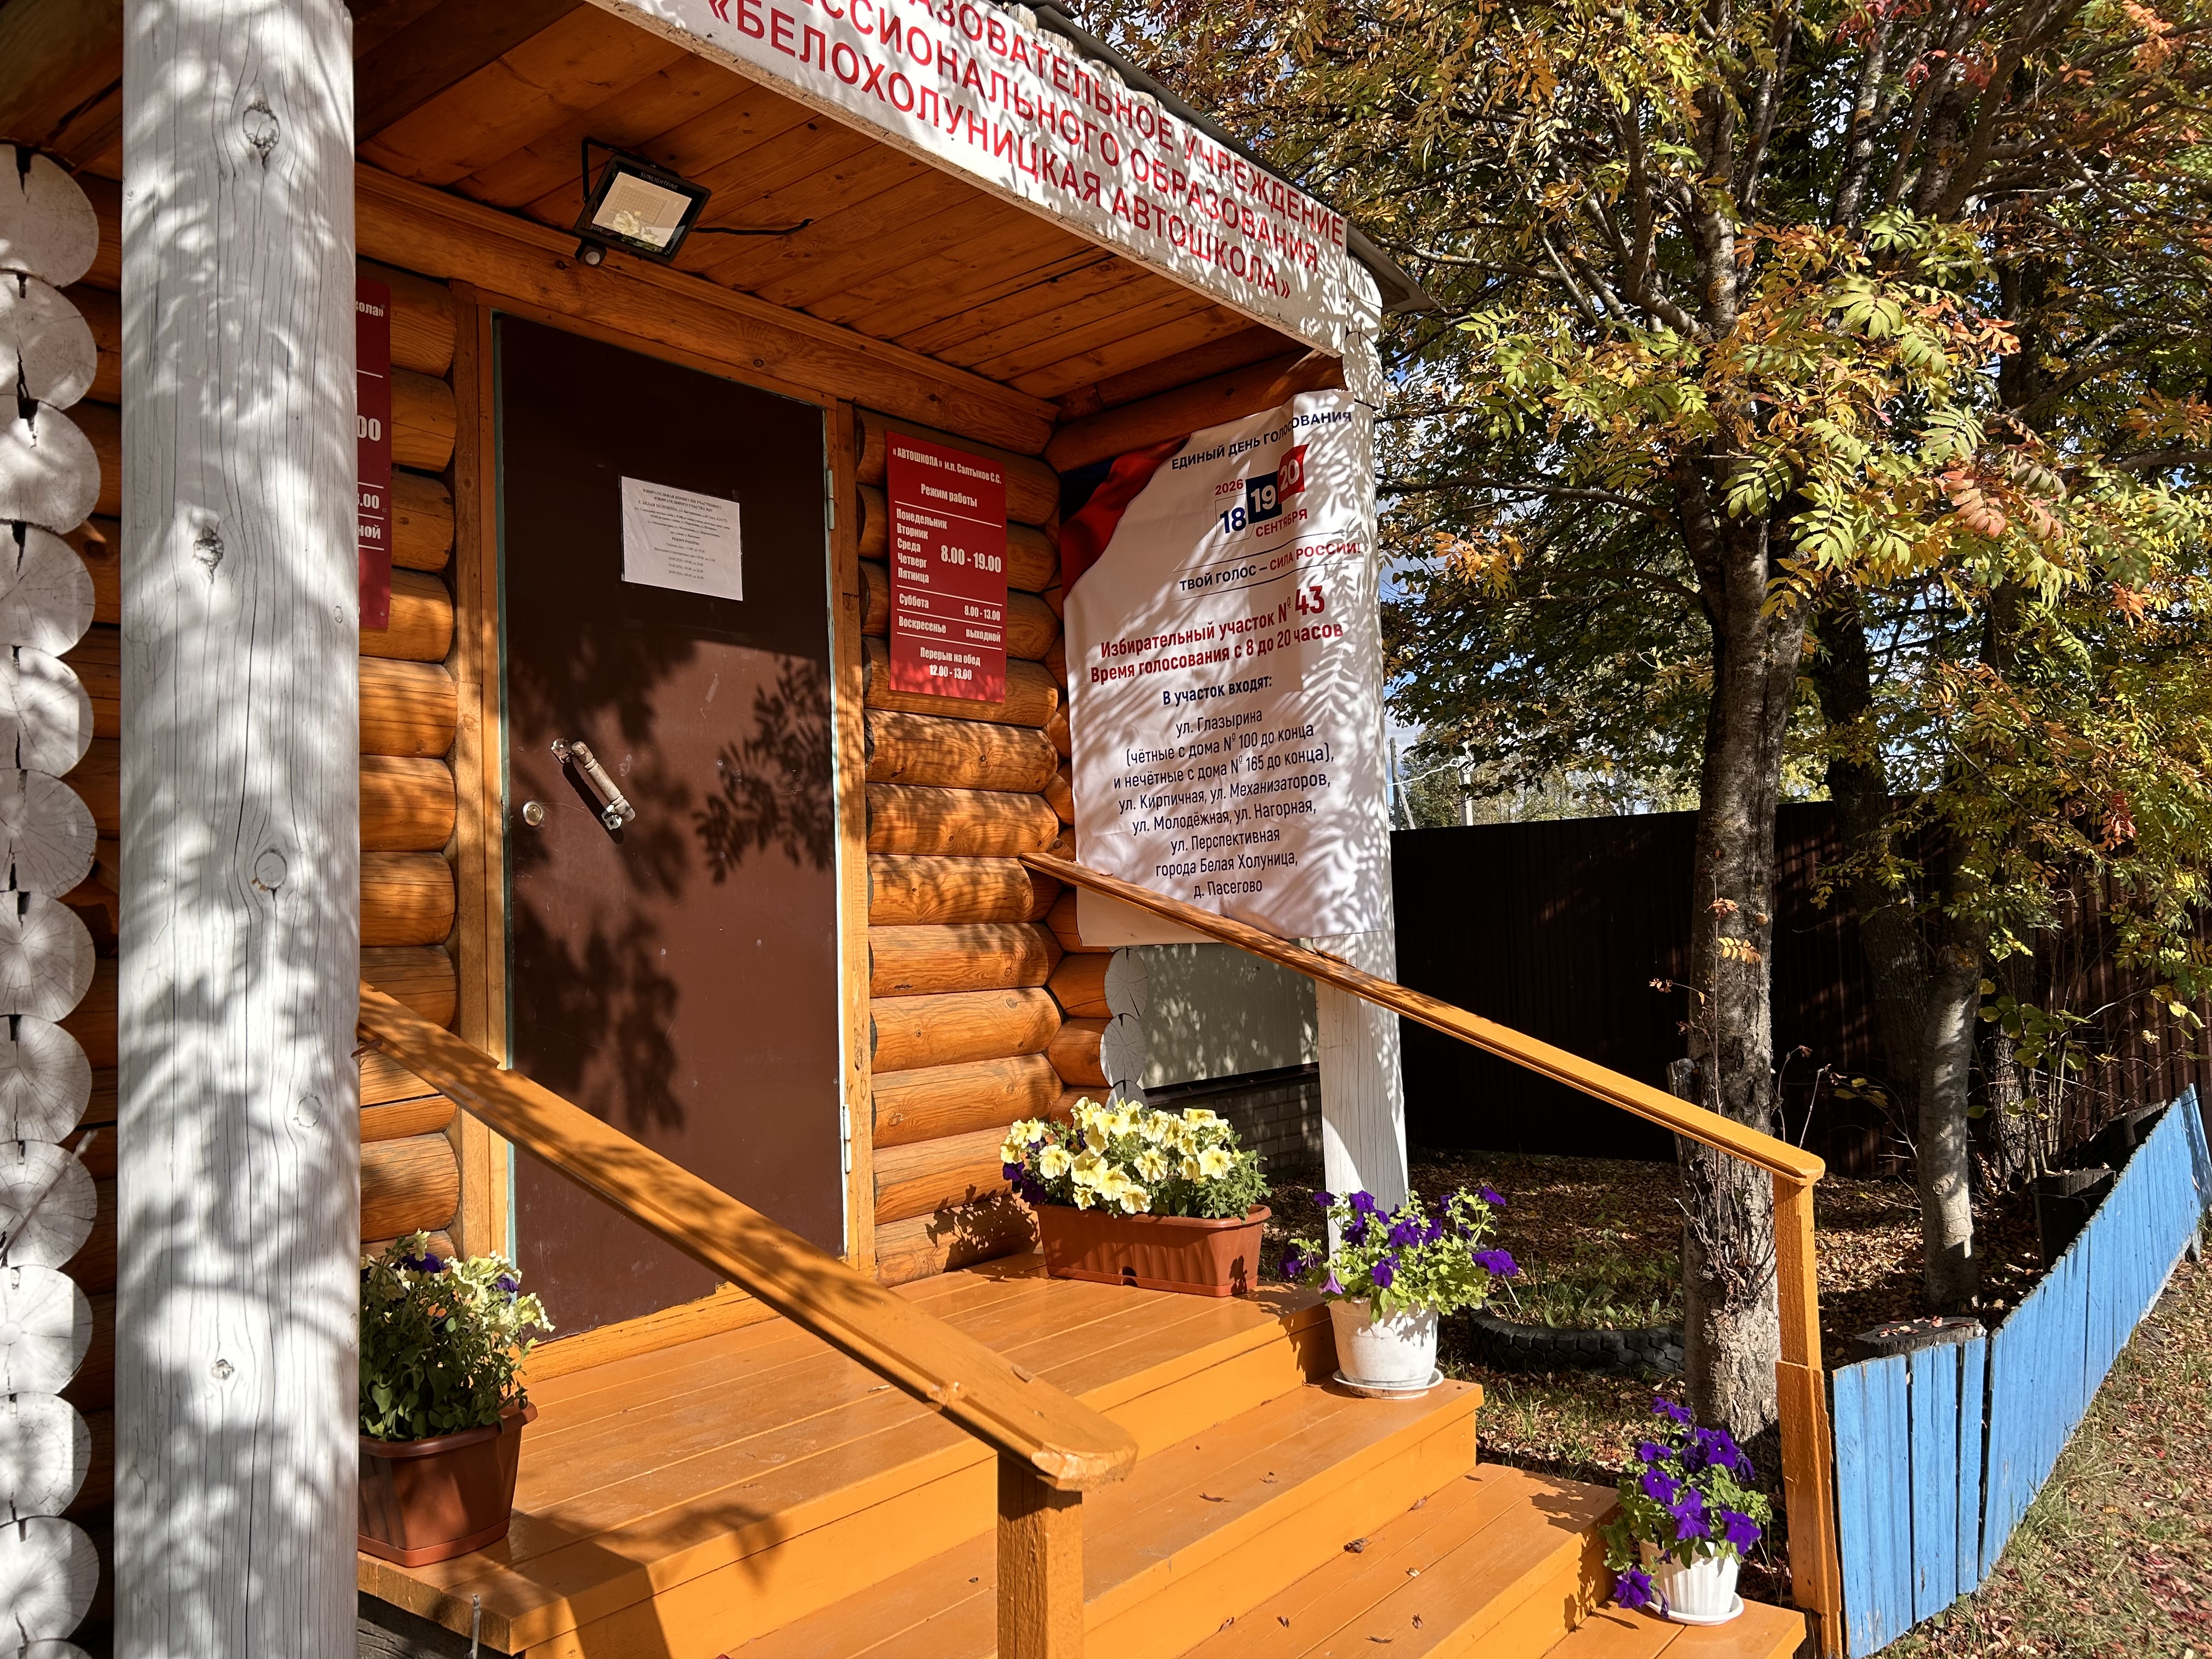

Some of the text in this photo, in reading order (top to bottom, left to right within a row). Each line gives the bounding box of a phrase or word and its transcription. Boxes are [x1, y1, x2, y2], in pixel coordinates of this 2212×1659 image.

[802, 0, 1317, 272] СИОНАЛЬНОГО ОБРАЗОВАНИЯ
[1183, 129, 1343, 245] УЧРЕЖДЕНИЕ
[1113, 187, 1290, 297] АВТОШКОЛА»
[1172, 411, 1352, 470] ЕДИНЫЙ ДЕНЬ ГОЛОСОВАНИЯ
[957, 464, 989, 480] Салтыков
[921, 483, 977, 507] Режим работы
[1215, 479, 1243, 495] 2026
[1220, 459, 1300, 533] 18 19 20
[896, 508, 947, 529] Понедельник
[897, 523, 928, 539] Вторник
[1256, 509, 1307, 537] СЕНТЯБРЯ
[898, 538, 921, 553] Среда
[941, 545, 964, 565] 8.00
[973, 552, 1001, 573] 19.00
[898, 552, 927, 568] Четверг
[1180, 572, 1212, 591] ТВОЙ
[1216, 565, 1256, 584] ГОЛОС
[1270, 552, 1293, 570] СИЛА
[1296, 540, 1361, 560] РОССИИ!
[898, 567, 929, 584] Пятница
[899, 594, 929, 608] Суббота
[964, 605, 979, 617] 8.00
[984, 609, 1000, 621] 13.00
[1101, 622, 1214, 658] Избирательный
[1219, 612, 1274, 641] участок
[1295, 585, 1324, 616] 43
[899, 616, 1000, 642] Воскресенье выходной
[921, 647, 980, 667] Перерыв на обед
[1091, 624, 1343, 685] Время голосования с 8 до 20 часов
[929, 664, 948, 677] 12.00
[953, 668, 972, 680] 13.00
[1163, 676, 1272, 707] В участок входят:
[1176, 710, 1262, 738] ул. Глазырина
[1127, 748, 1174, 766] (чётные
[1178, 747, 1185, 758] с
[1189, 742, 1219, 759] дома
[1239, 732, 1257, 749] 100
[1261, 732, 1274, 748] до
[1278, 725, 1313, 742] конца
[1114, 778, 1120, 789] и
[1125, 771, 1183, 787] нечётные
[1188, 769, 1194, 780] с
[1198, 764, 1227, 781] дома
[1246, 755, 1263, 771] 165
[1267, 755, 1280, 771] до
[1285, 742, 1334, 765] конца),
[1119, 774, 1330, 814] ул. Кирпичная, ул. Механизаторов,
[1132, 800, 1316, 836] ул. Молодёжная, ул. Нагорная,
[1171, 830, 1279, 855] ул. Перспективная
[1156, 853, 1297, 879] города Белая Холуница,
[1194, 881, 1262, 899] д. Пасегово
